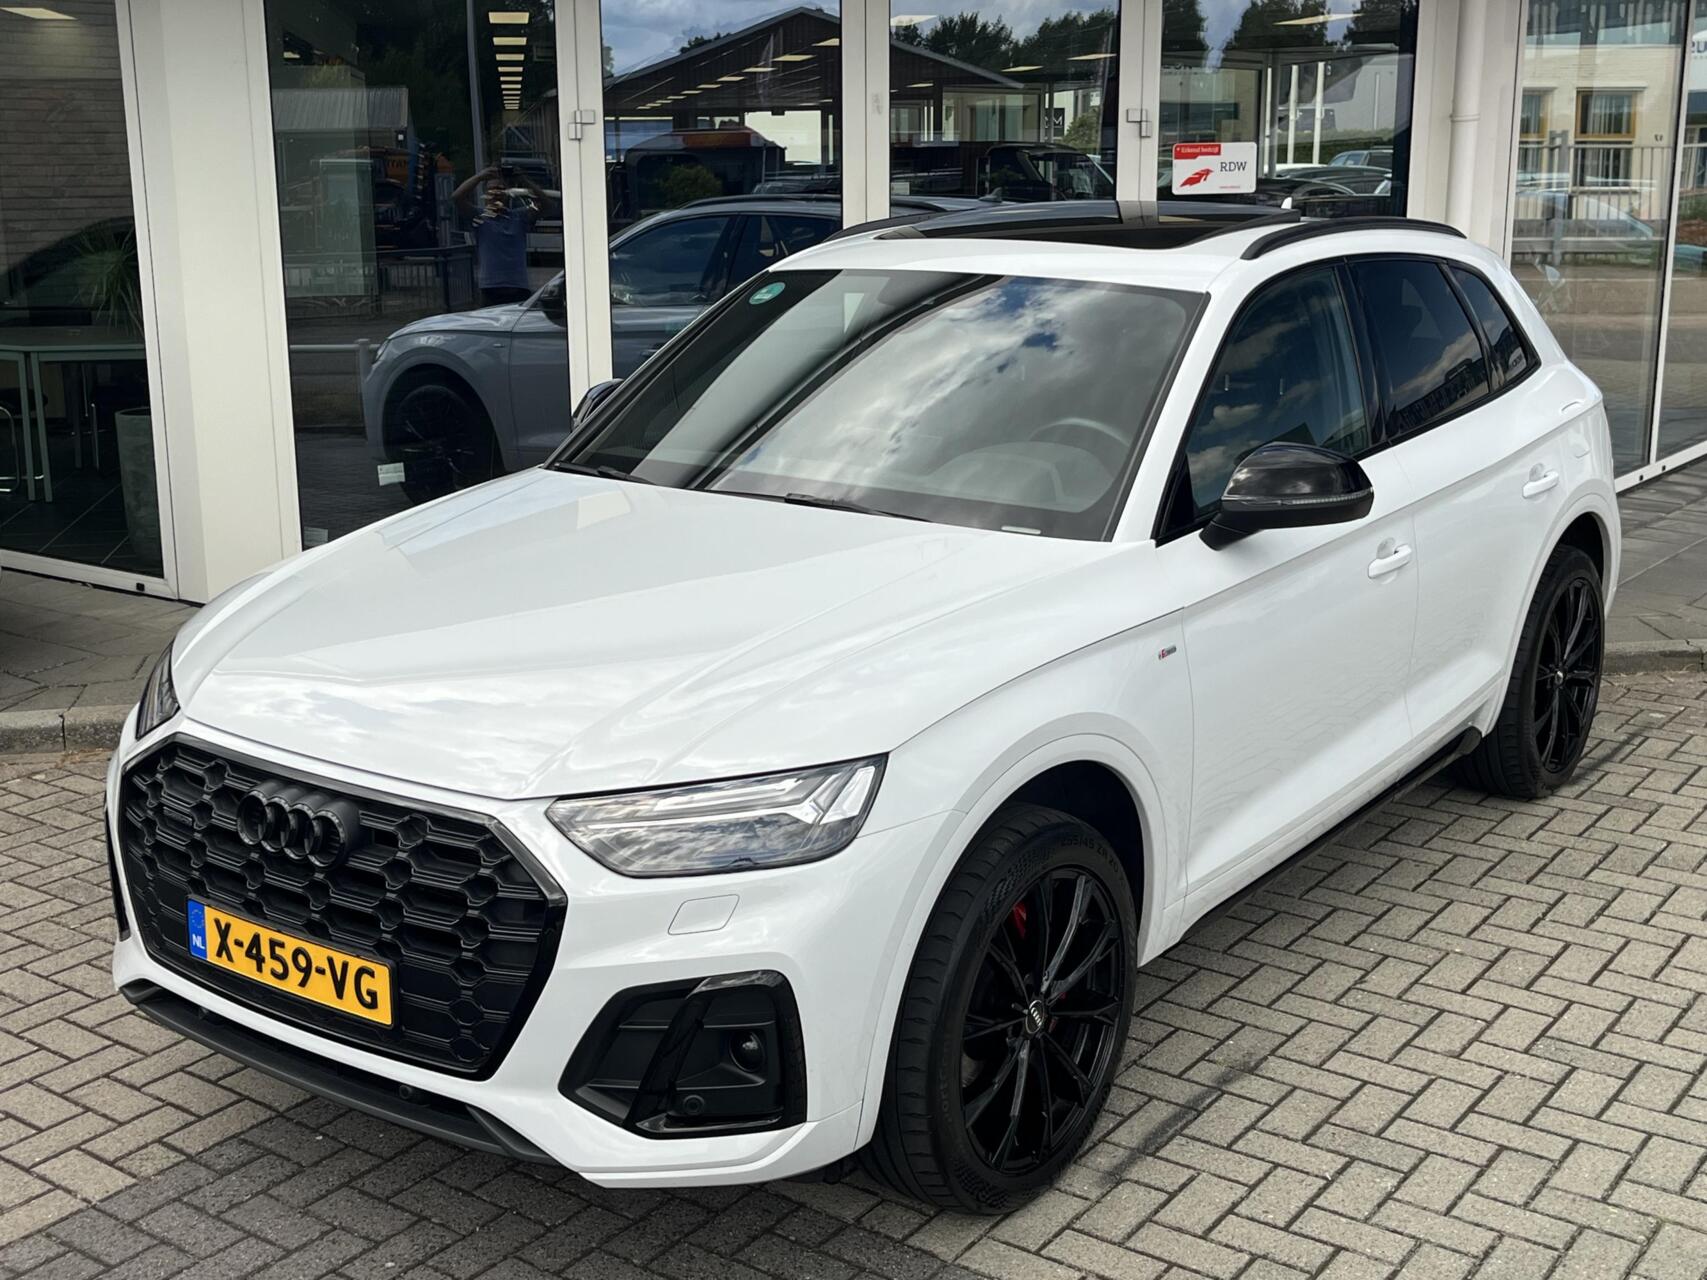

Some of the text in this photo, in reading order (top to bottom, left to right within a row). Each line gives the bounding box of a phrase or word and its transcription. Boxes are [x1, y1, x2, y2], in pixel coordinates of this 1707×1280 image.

[1220, 161, 1247, 172] RDW
[192, 934, 205, 950] NL
[213, 917, 379, 1010] X-459-VG
